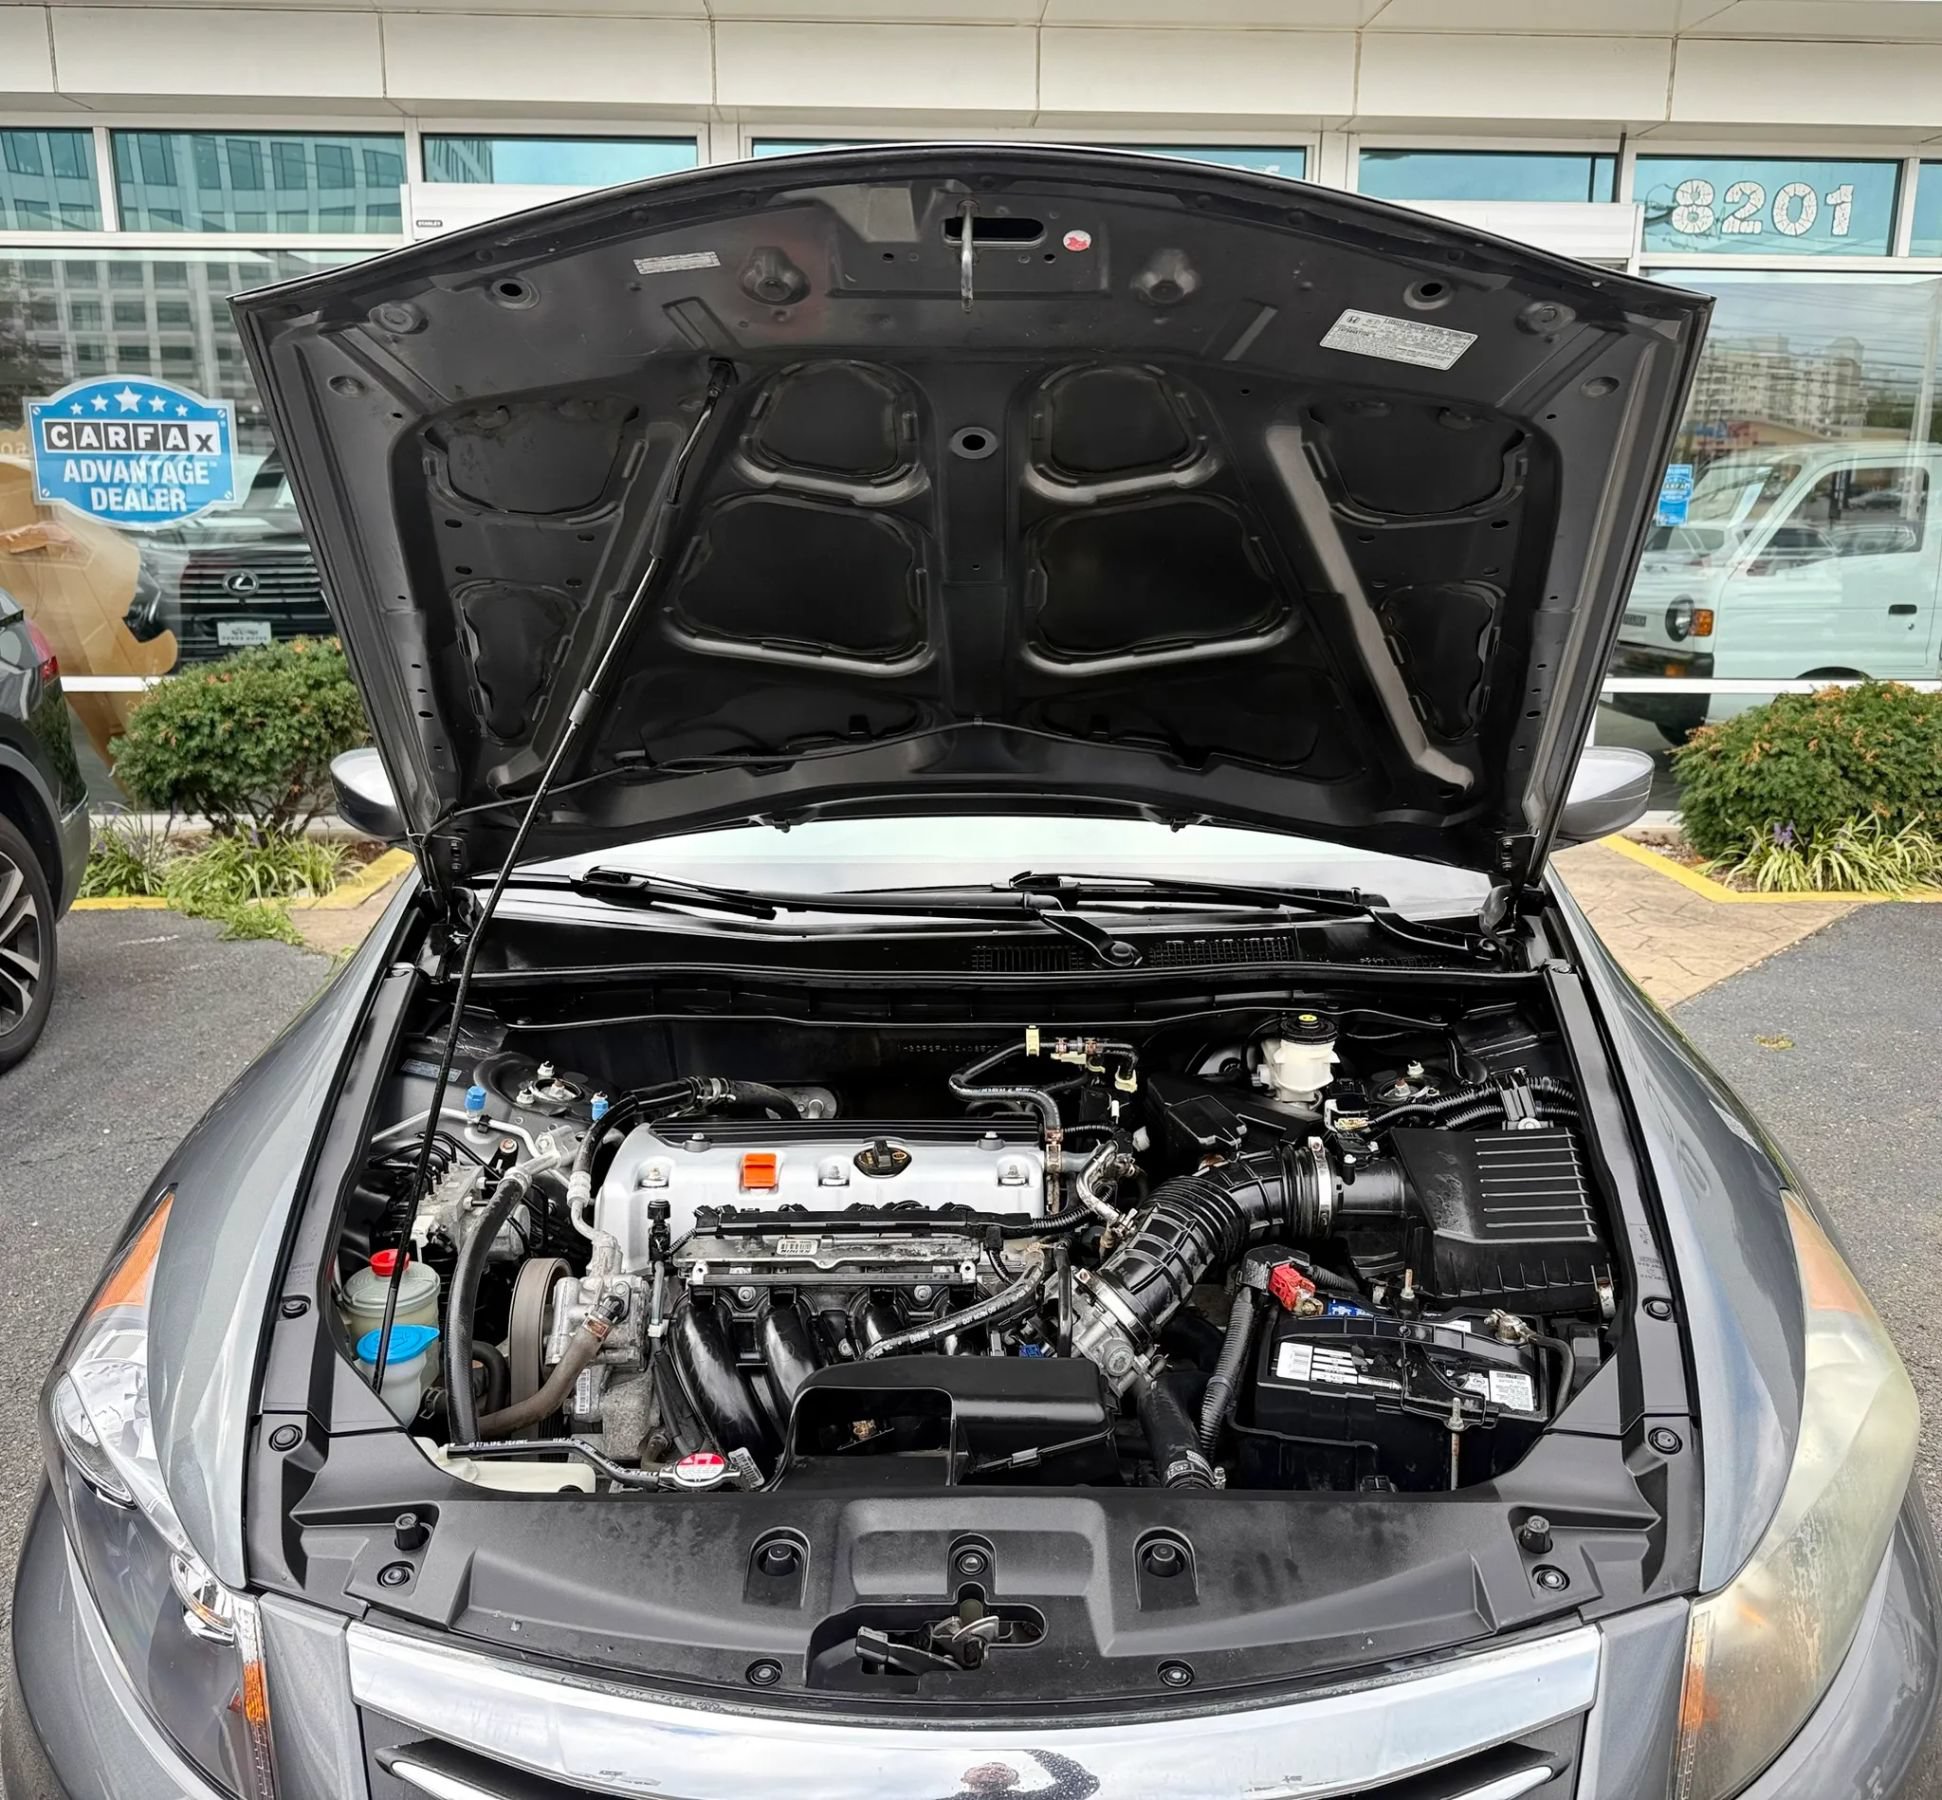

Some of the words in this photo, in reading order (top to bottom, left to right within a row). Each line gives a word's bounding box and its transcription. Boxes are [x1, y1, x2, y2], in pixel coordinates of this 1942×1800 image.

[1671, 178, 1854, 236] 8201
[50, 424, 214, 453] CARFAX
[63, 459, 210, 484] ADVANTAGE
[90, 487, 187, 512] DEALER
